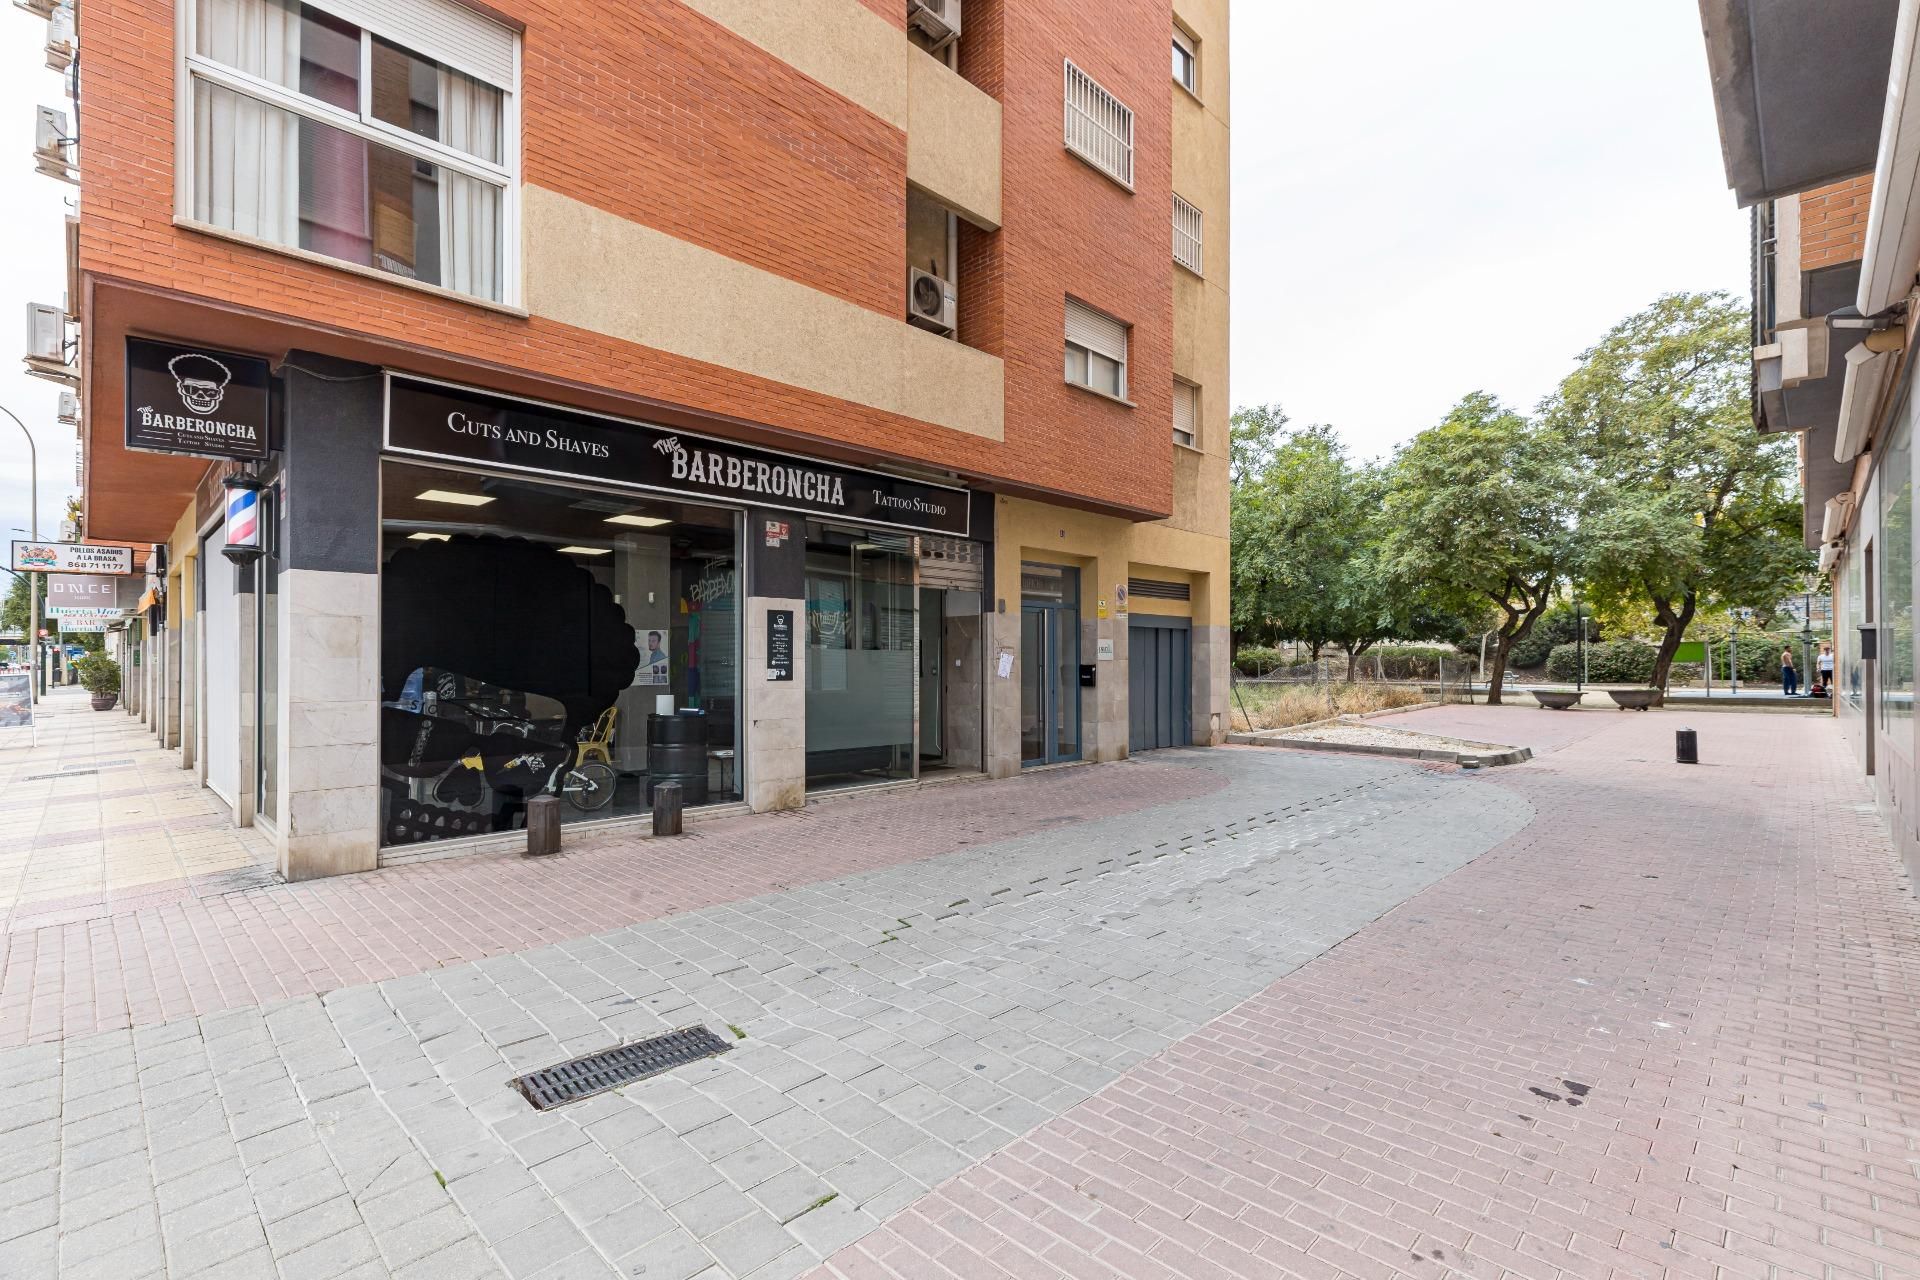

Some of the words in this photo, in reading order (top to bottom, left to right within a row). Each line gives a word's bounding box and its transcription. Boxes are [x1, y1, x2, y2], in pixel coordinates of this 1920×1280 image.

[137, 405, 154, 414] THE
[142, 412, 257, 440] BARBERONCHA
[447, 411, 501, 440] CUTS
[505, 428, 541, 446] AND
[545, 429, 609, 458] SHAVES
[652, 436, 681, 456] THE
[671, 448, 845, 506] BARBERONCHA
[872, 489, 912, 510] TATTOO
[913, 500, 947, 516] STUDIO
[96, 548, 123, 556] ASADOS
[54, 583, 112, 594] ONCE
